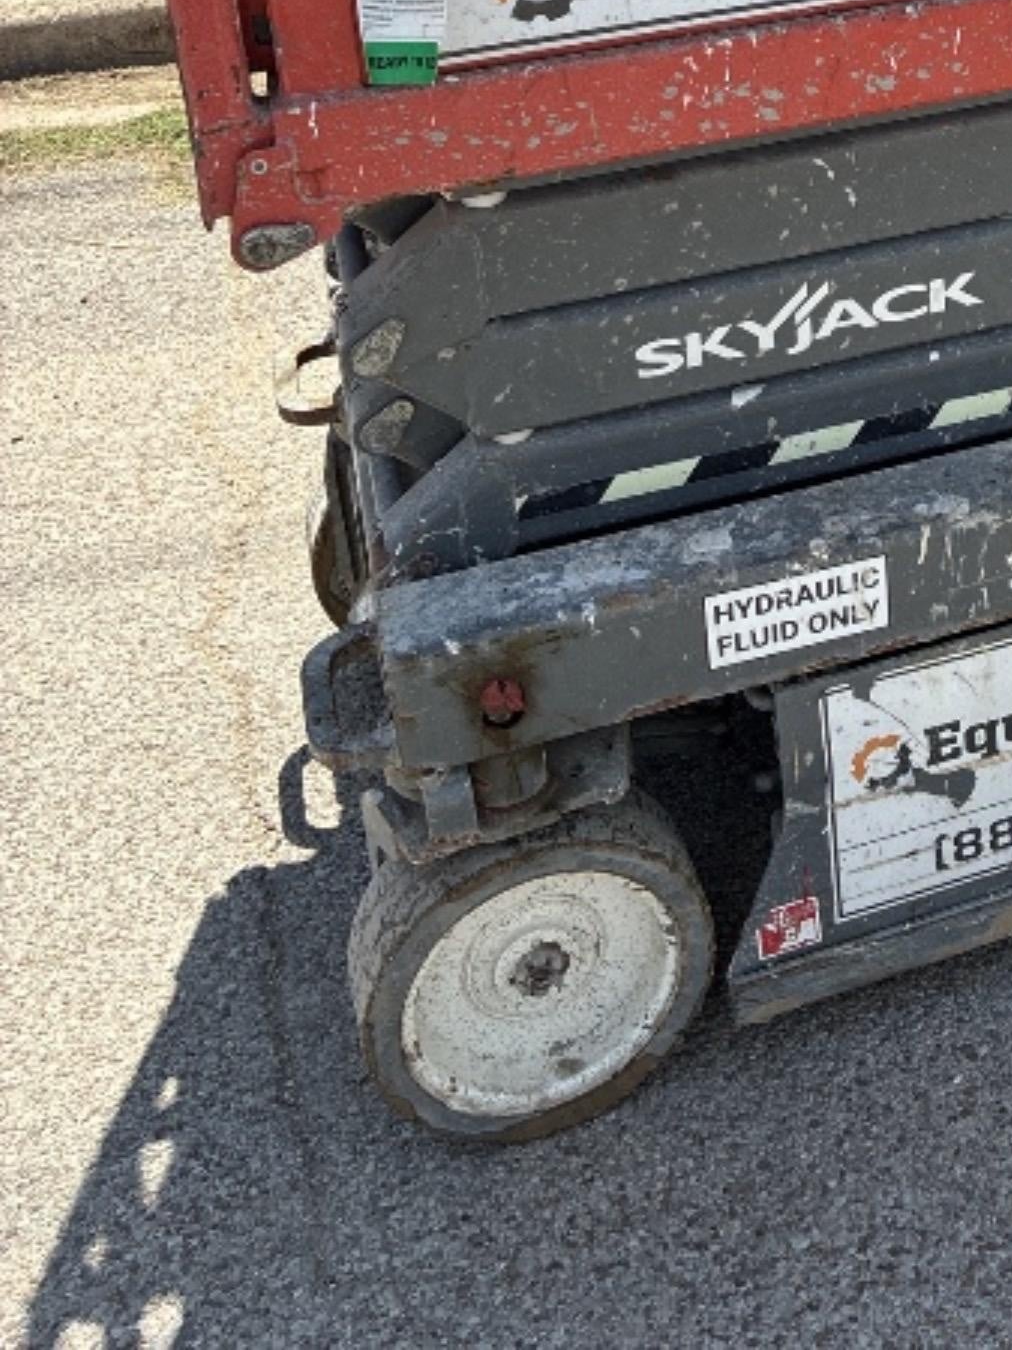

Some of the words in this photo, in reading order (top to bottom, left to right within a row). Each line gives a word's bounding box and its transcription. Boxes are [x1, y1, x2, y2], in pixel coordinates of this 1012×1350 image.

[635, 271, 984, 379] SKYJACK
[713, 566, 879, 625] HYDRAULIC
[716, 620, 799, 658] FLUID
[808, 599, 880, 634] ONLY
